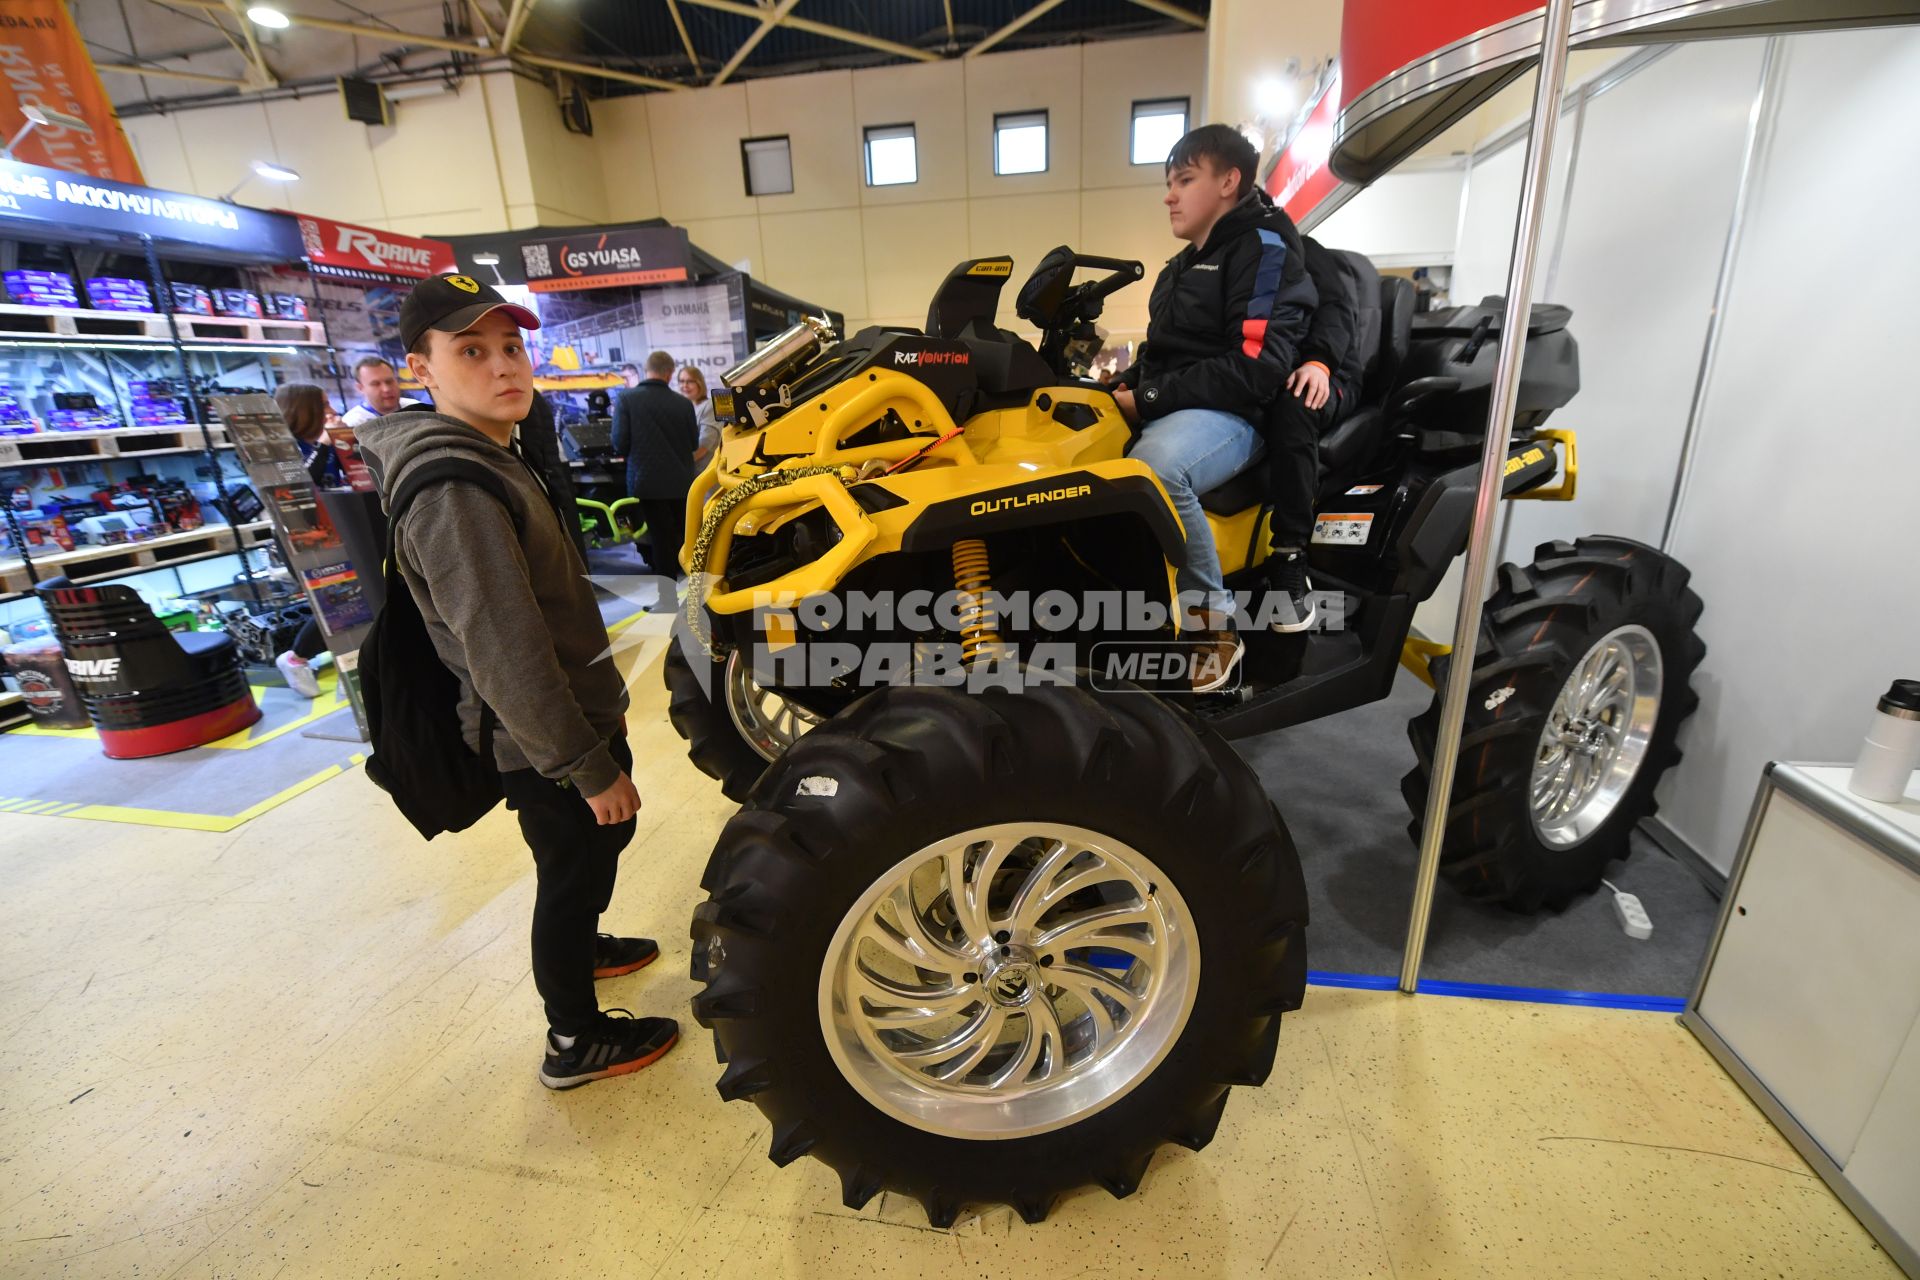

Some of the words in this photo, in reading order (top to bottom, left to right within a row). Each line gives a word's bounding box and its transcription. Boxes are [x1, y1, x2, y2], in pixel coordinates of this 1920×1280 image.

[567, 252, 589, 268] GS
[588, 247, 640, 266] YUASA
[672, 302, 710, 316] YAMAHA
[970, 484, 1091, 516] OUTLANDER
